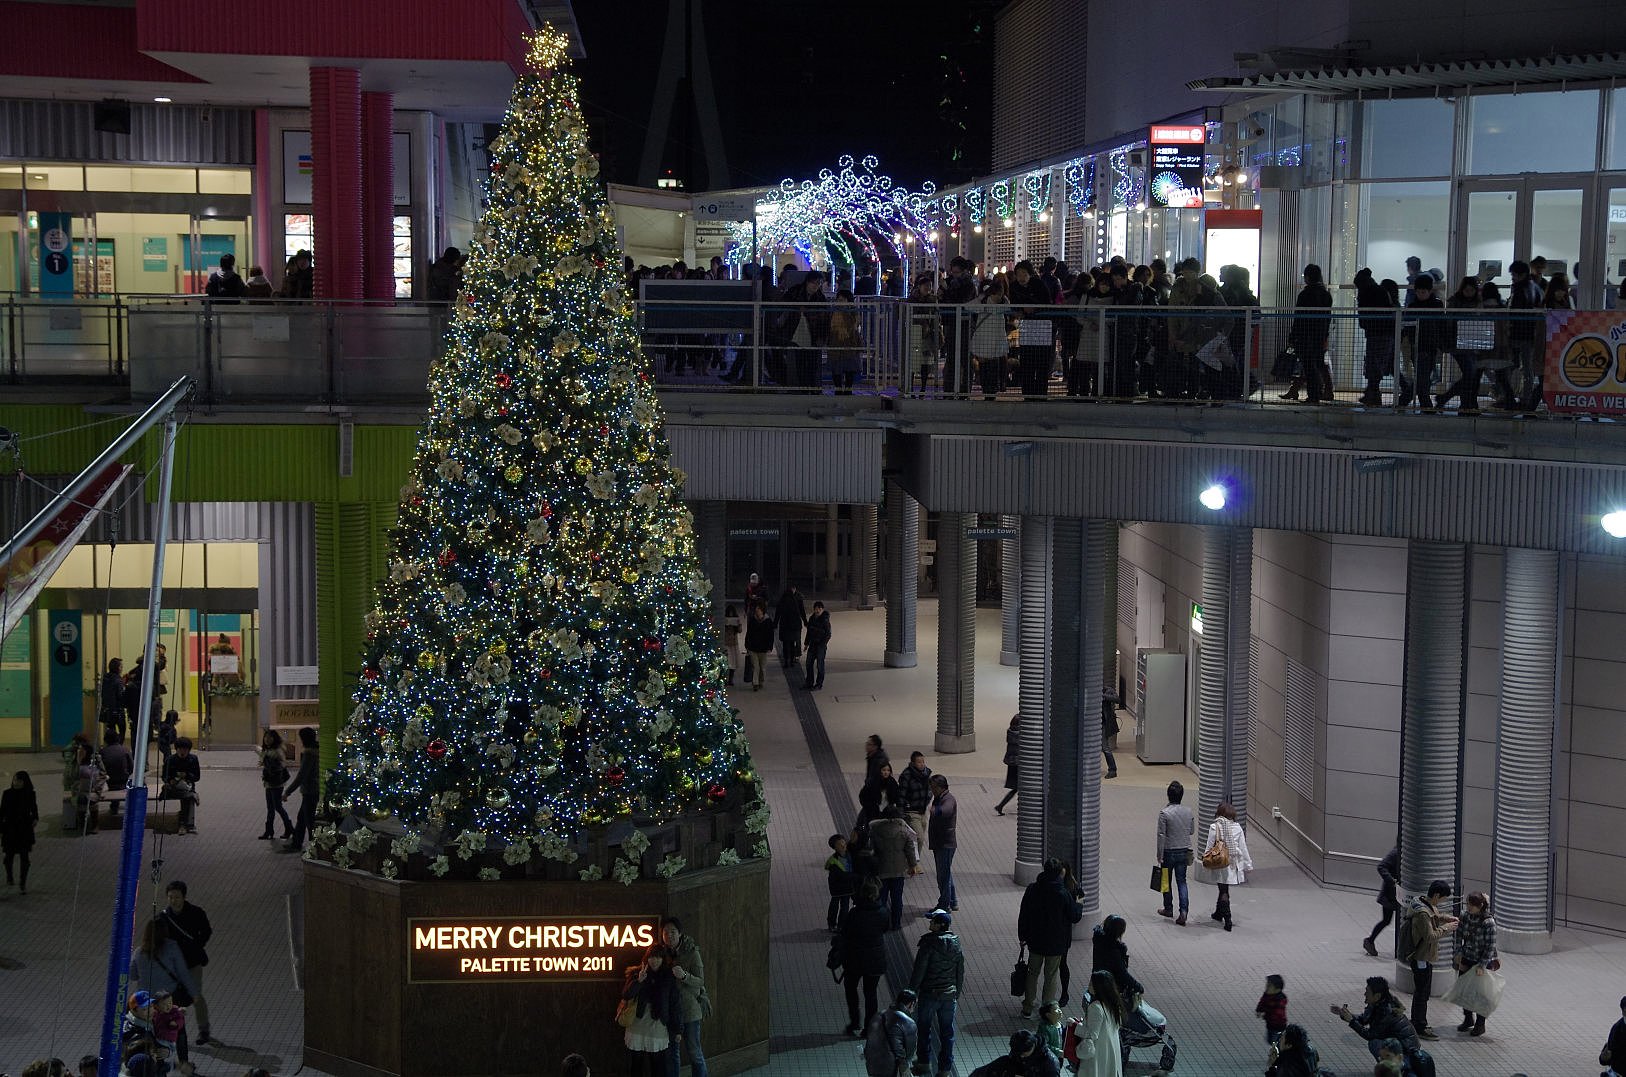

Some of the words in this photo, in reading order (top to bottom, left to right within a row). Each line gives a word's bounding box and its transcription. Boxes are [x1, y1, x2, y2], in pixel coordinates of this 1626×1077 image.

[53, 259, 59, 272] 1
[1554, 394, 1597, 408] MEGA
[1603, 395, 1626, 409] WE
[729, 528, 758, 536] palette
[63, 651, 69, 663] 1
[415, 926, 503, 950] MERRY
[508, 924, 654, 949] CHRISTMAS
[461, 957, 530, 973] PALETTE
[533, 957, 578, 972] TOWN
[584, 956, 613, 971] 2011
[111, 973, 128, 1051] JUMPZONE
